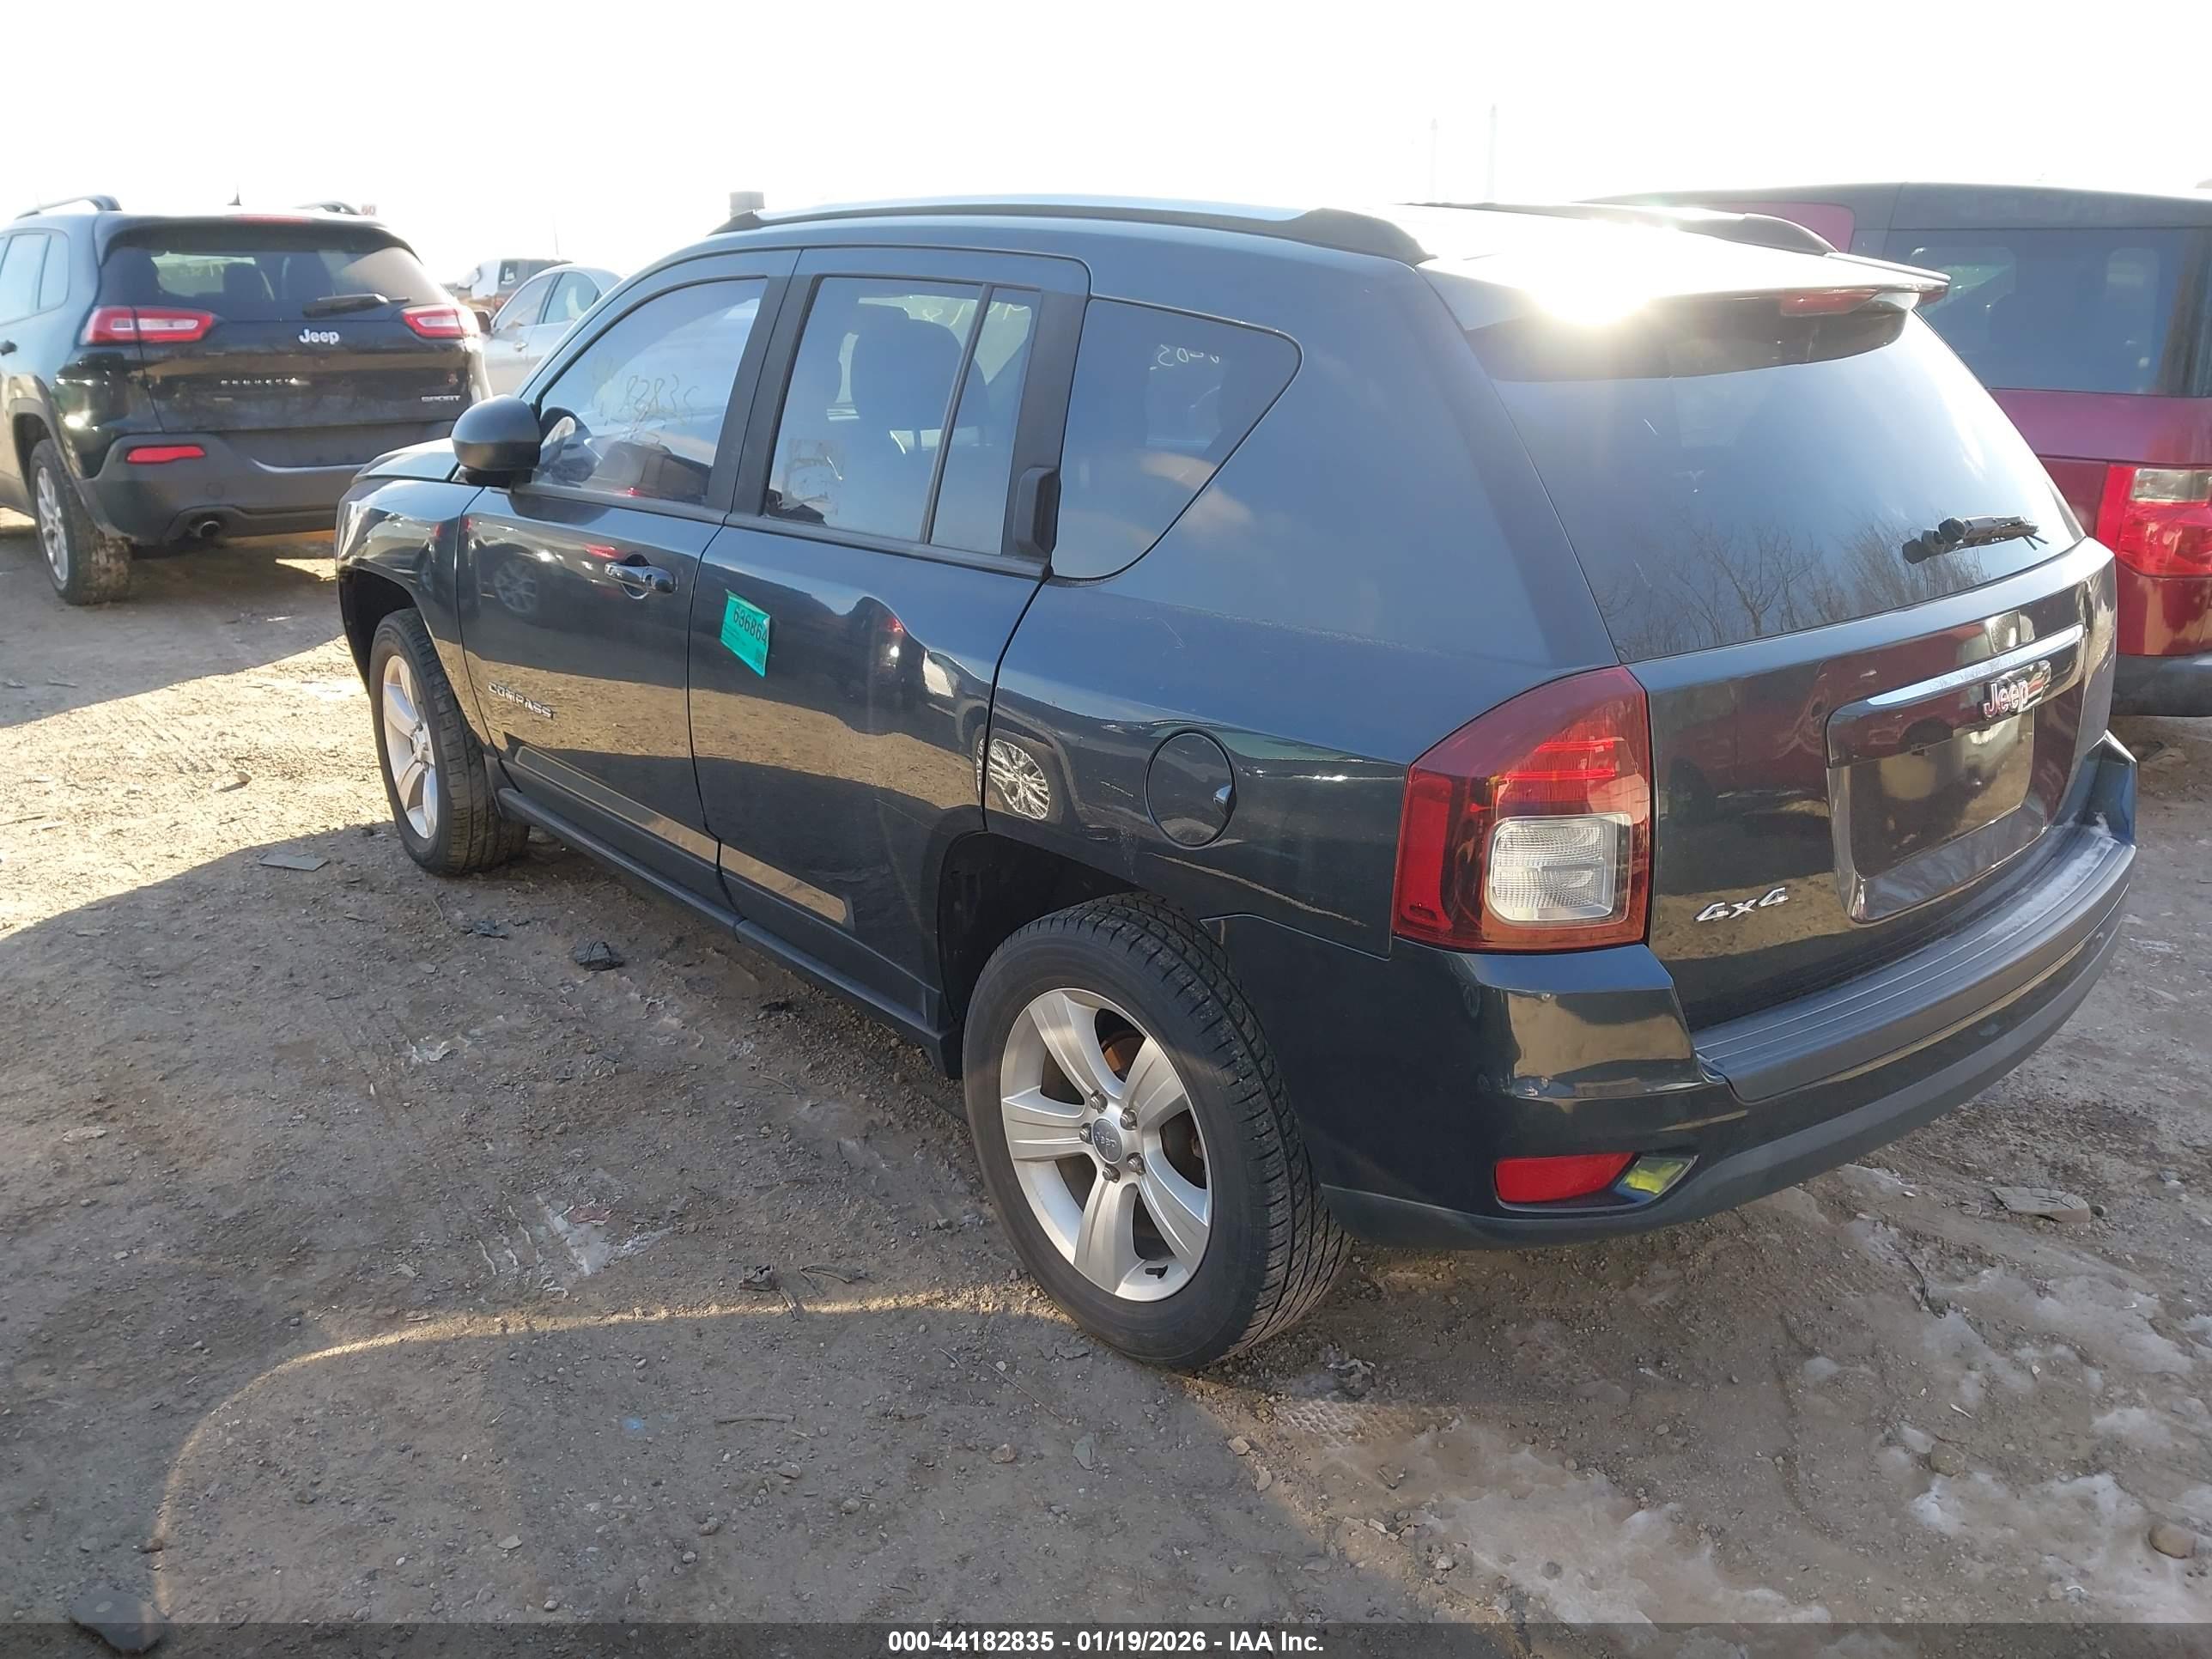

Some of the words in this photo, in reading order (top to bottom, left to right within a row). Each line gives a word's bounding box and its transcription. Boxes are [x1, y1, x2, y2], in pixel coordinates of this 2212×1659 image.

[298, 328, 340, 345] Jeep
[733, 605, 768, 647] 636864
[488, 681, 554, 719] COMPASS
[1983, 679, 2029, 719] Jeep
[1695, 886, 1790, 921] 4x4
